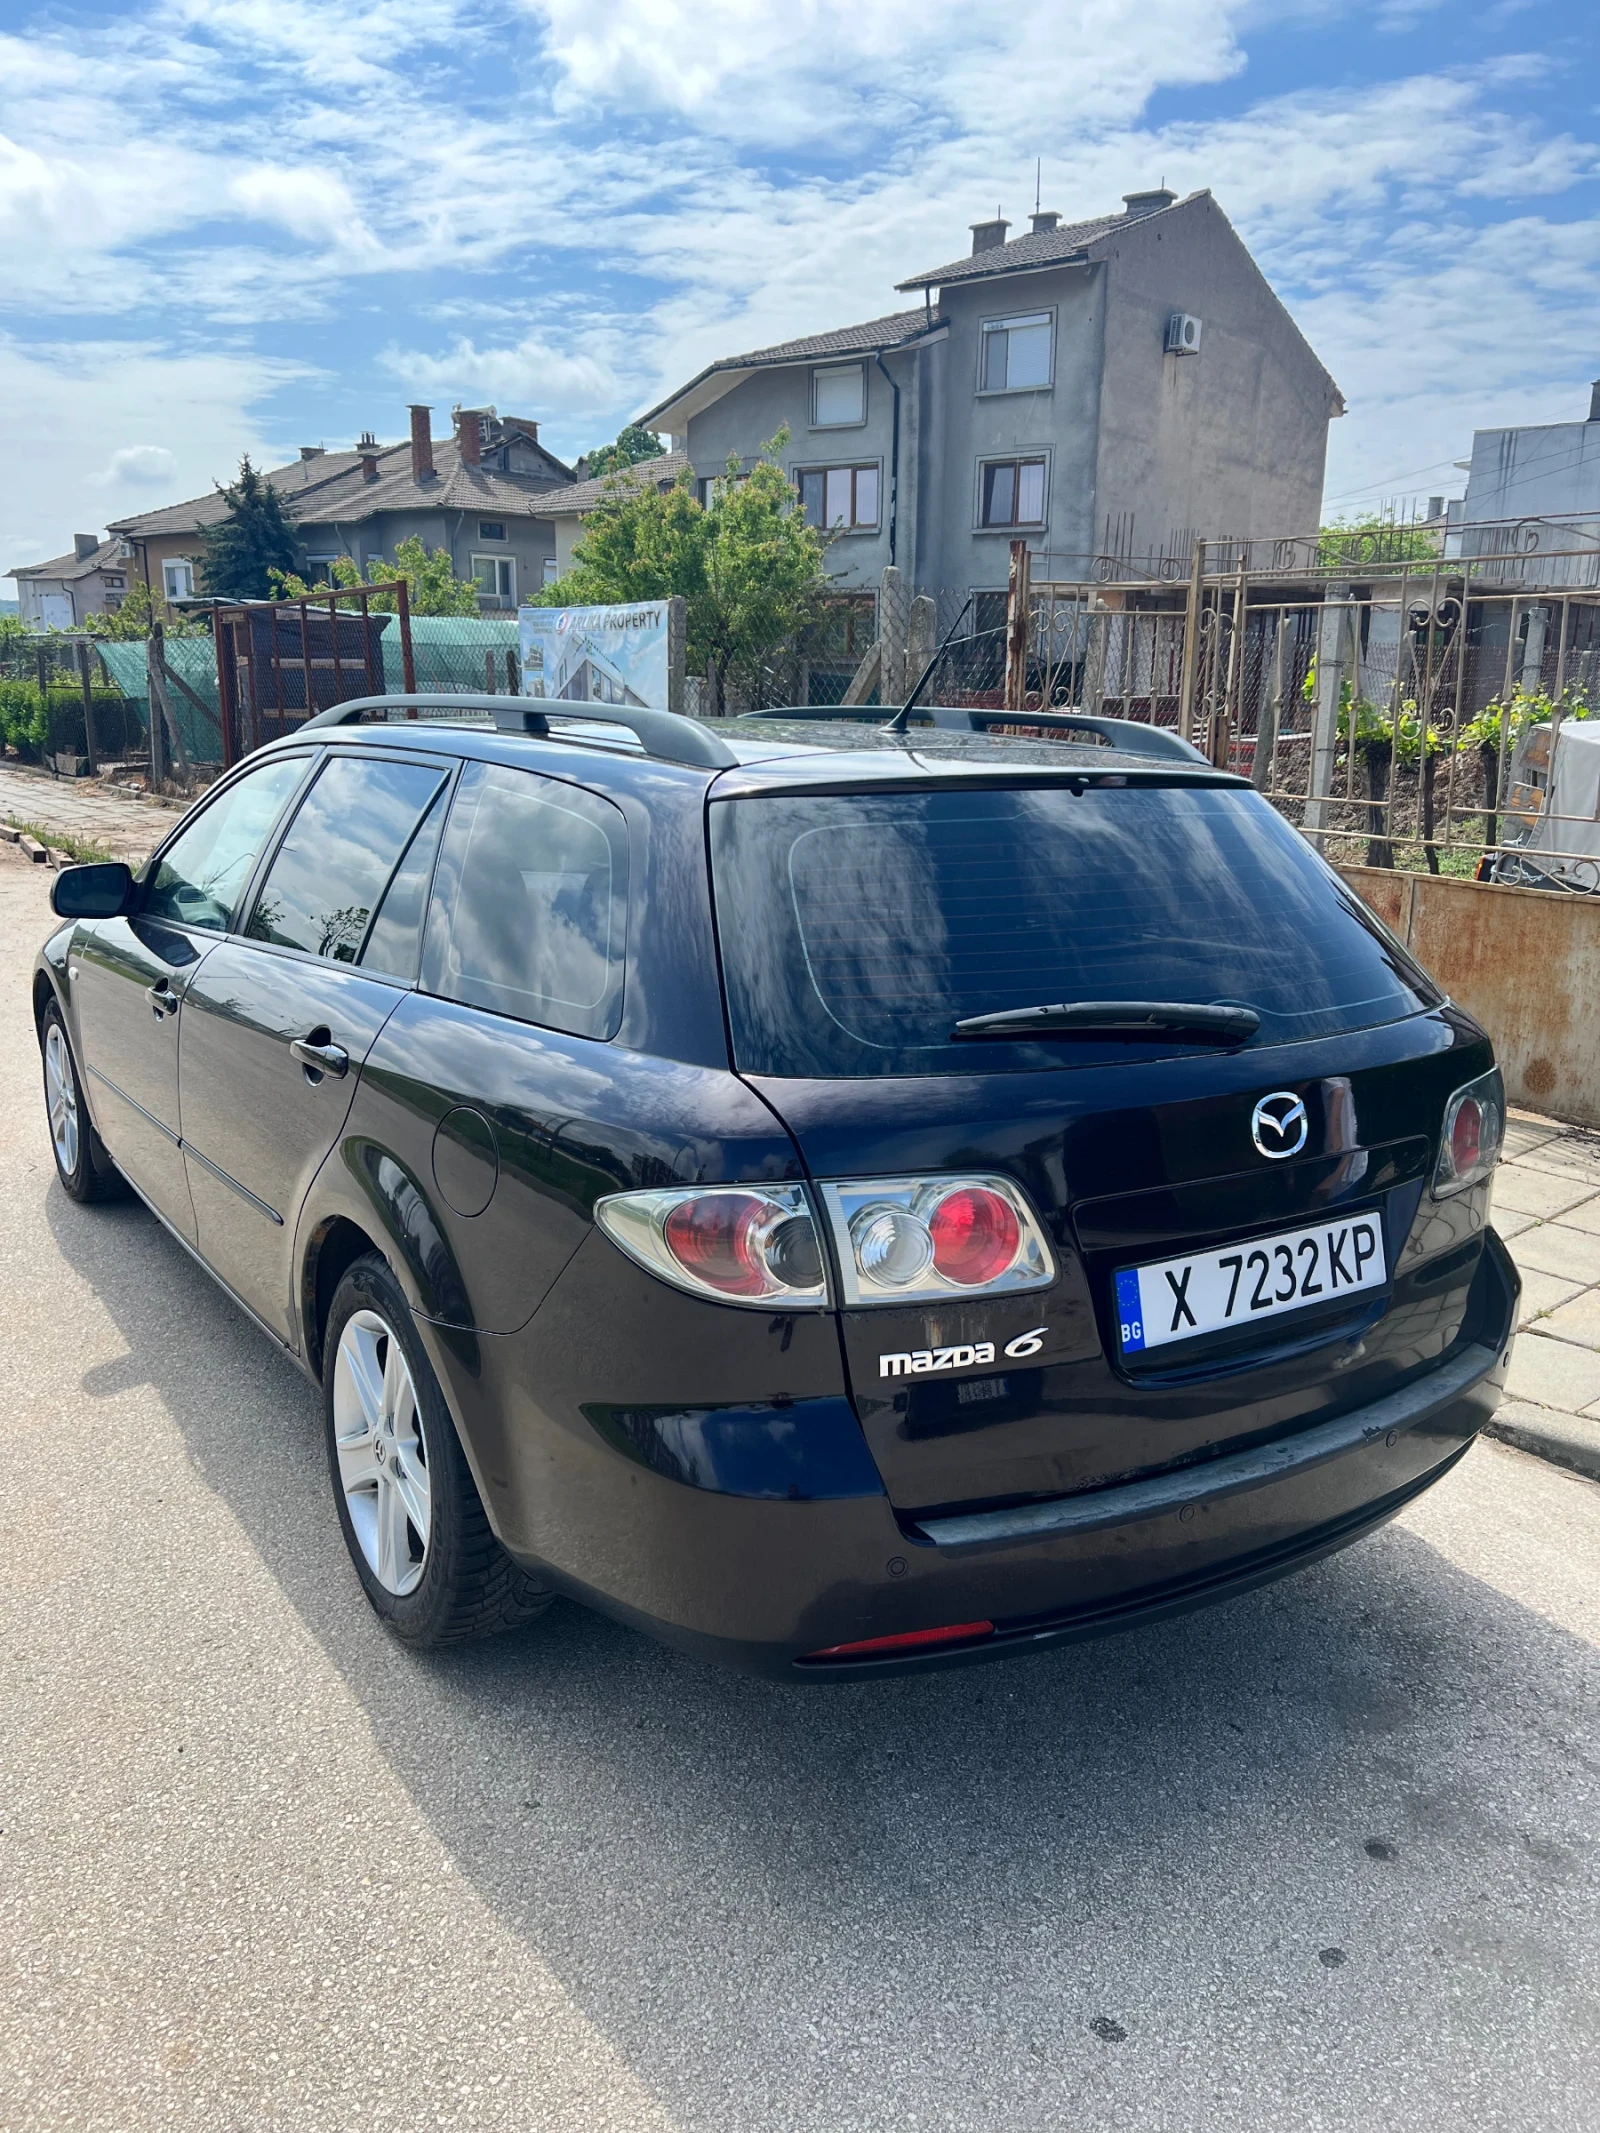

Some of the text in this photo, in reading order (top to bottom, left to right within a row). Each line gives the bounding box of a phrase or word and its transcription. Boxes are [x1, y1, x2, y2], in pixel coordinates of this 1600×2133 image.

[603, 610, 661, 629] PROPERTY
[1164, 1265, 1198, 1332] X
[1003, 1326, 1050, 1358] 6
[1120, 1321, 1142, 1343] BG
